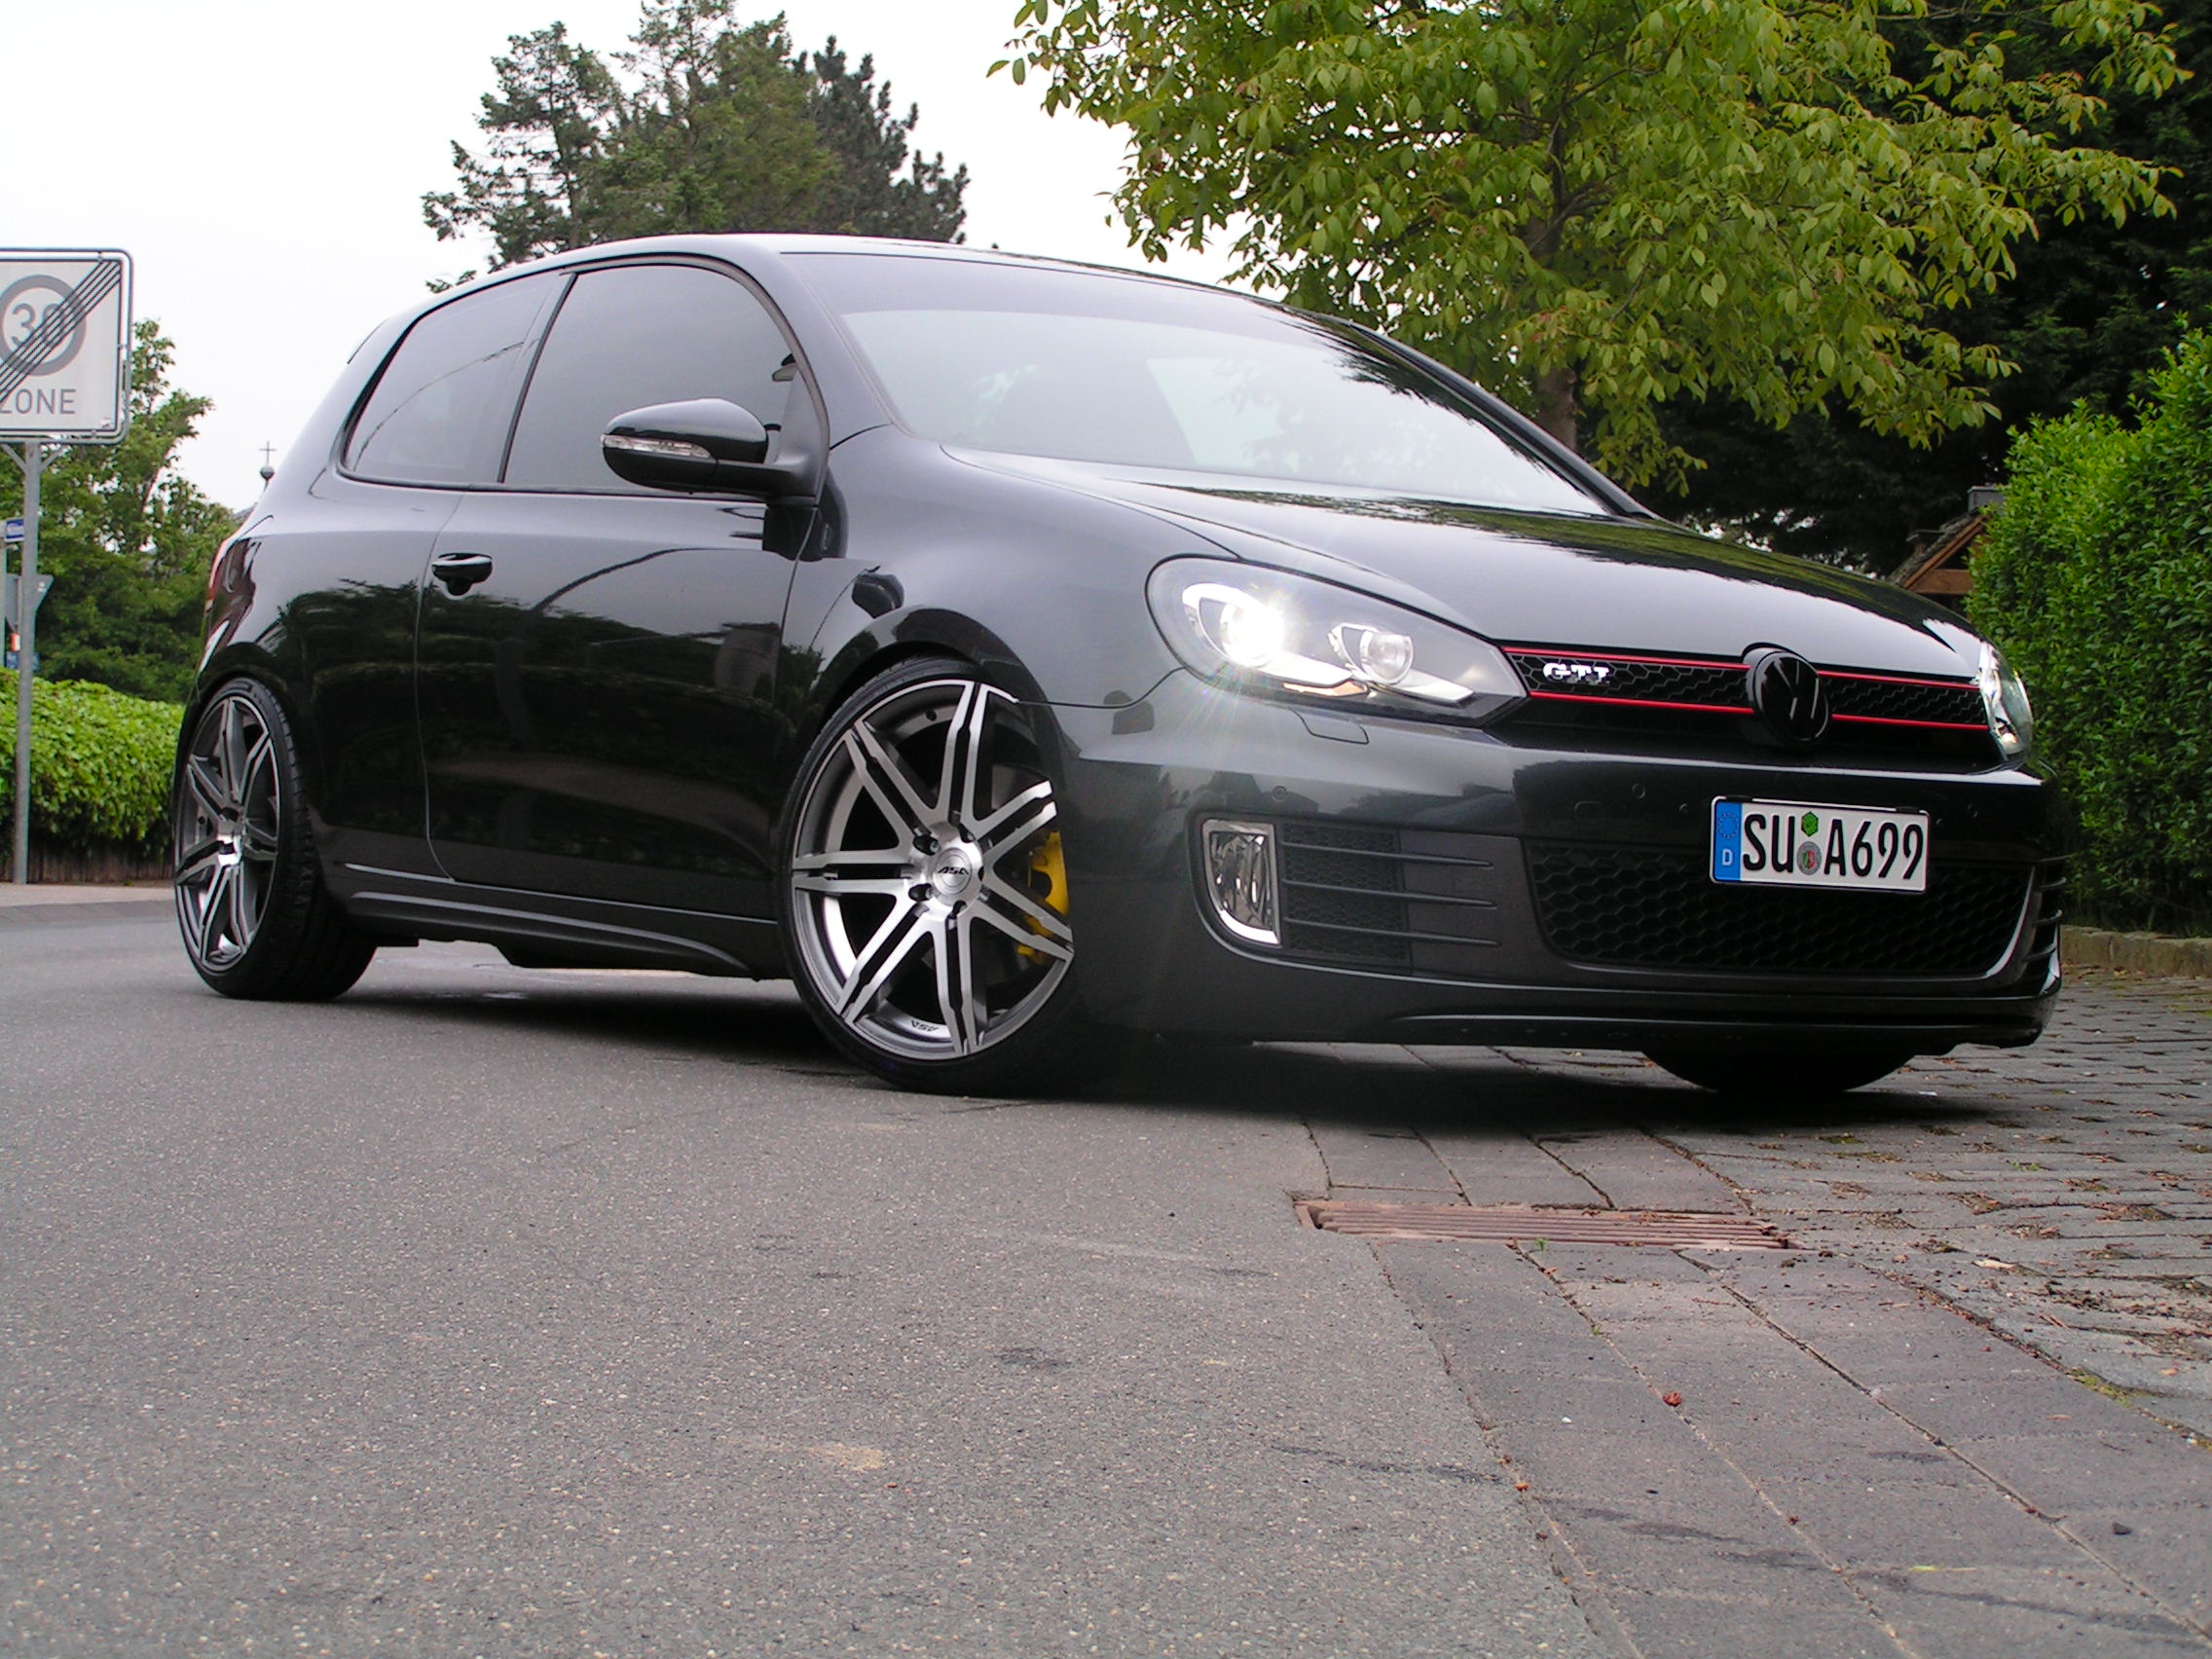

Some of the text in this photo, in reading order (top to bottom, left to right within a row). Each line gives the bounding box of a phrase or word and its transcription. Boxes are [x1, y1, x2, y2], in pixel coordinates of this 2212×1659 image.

[1542, 663, 1610, 683] GTI
[1742, 813, 1795, 873] SU
[1824, 818, 1924, 880] A699
[1721, 848, 1733, 866] D
[938, 866, 970, 874] ASA
